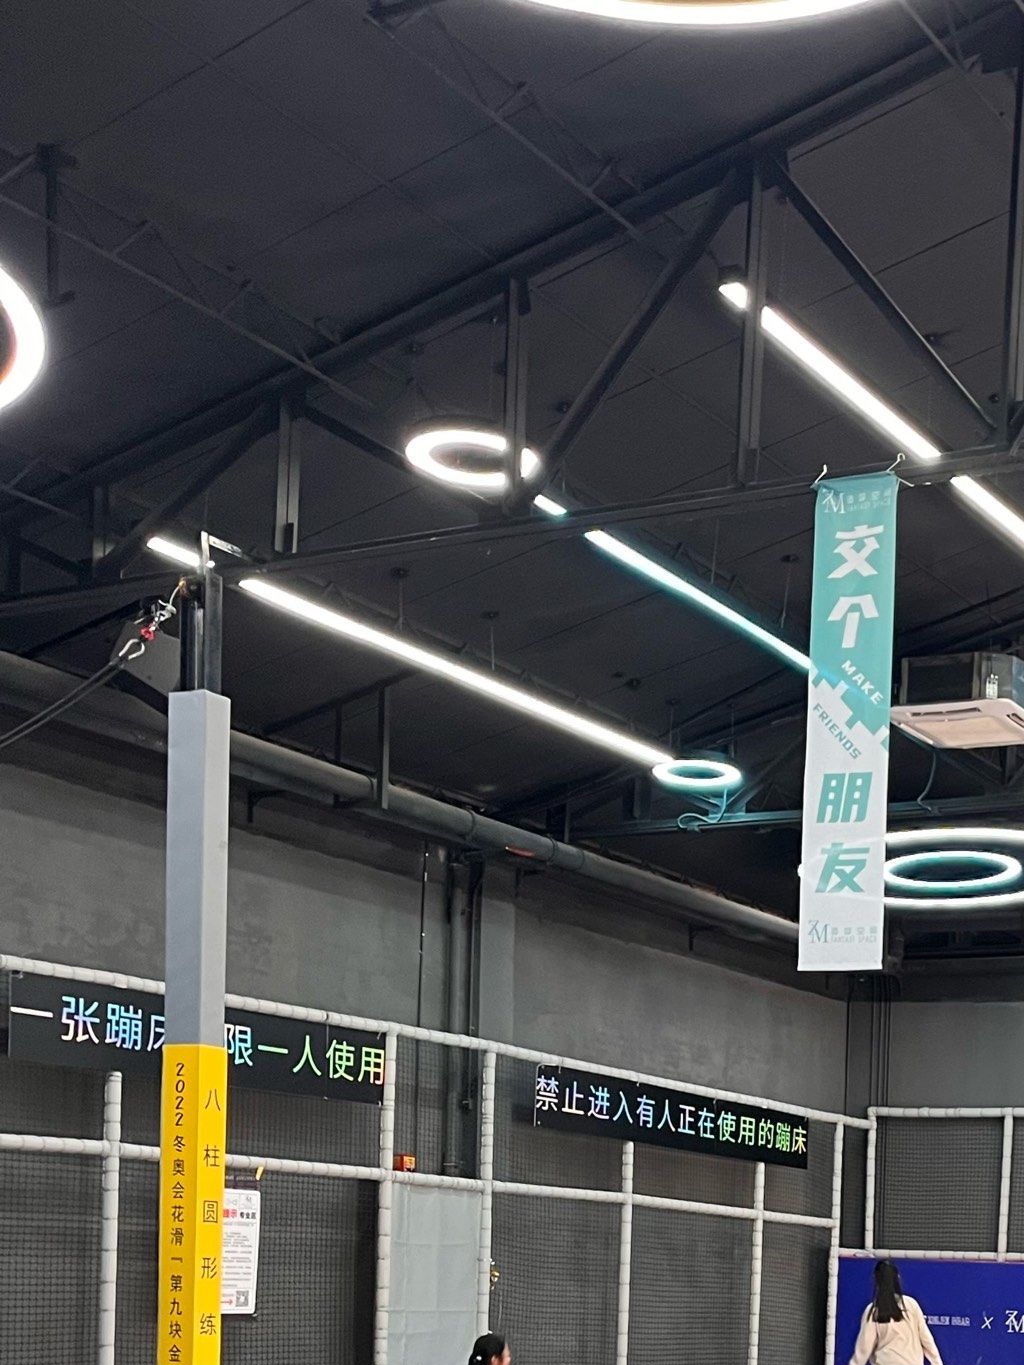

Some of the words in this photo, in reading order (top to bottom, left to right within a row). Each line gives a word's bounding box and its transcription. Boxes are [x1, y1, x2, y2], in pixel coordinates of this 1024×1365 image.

[841, 660, 883, 705] MAKE
[813, 703, 862, 759] FRIENDS
[10, 996, 385, 1085] 一张蹦限一人使用
[536, 1074, 808, 1155] 禁止进入有人正在使用的蹦床
